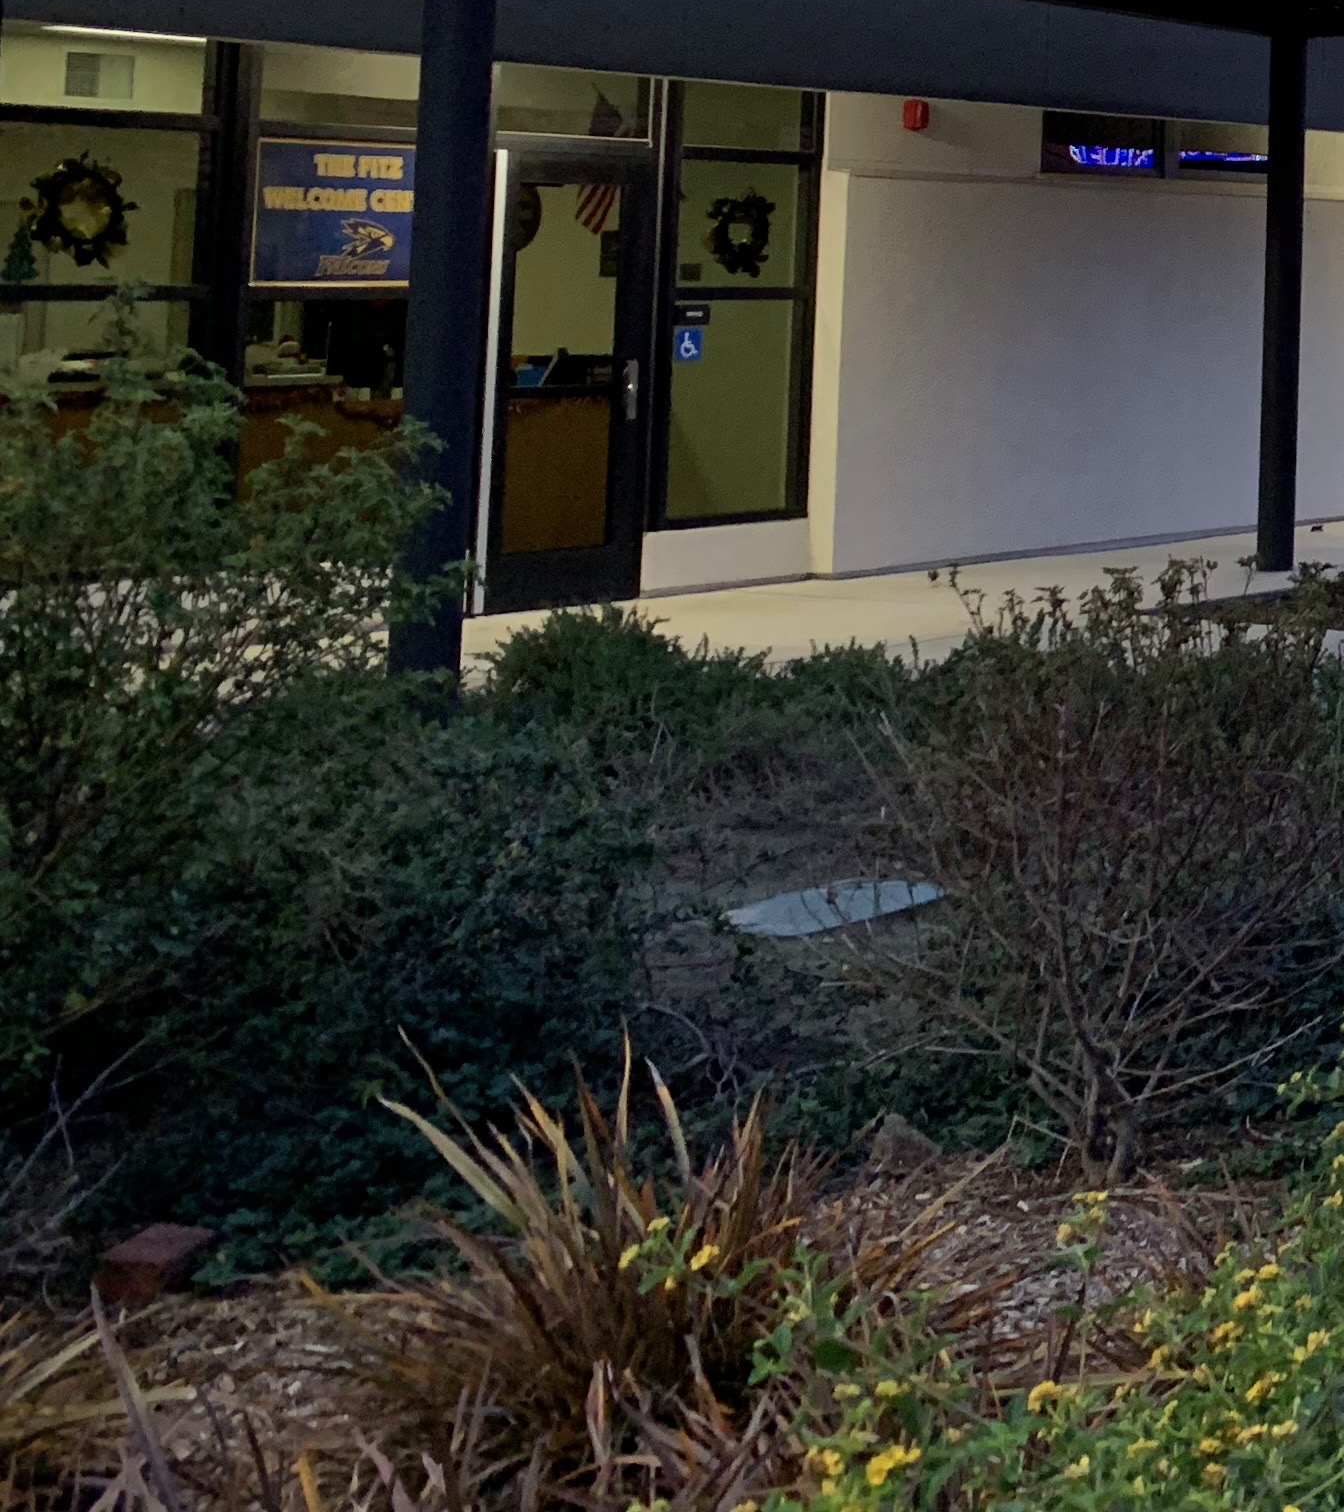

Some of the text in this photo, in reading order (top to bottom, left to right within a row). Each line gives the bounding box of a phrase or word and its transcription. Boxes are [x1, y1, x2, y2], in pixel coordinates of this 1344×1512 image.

[313, 153, 404, 180] THE FITZ
[263, 186, 368, 212] WELCOME
